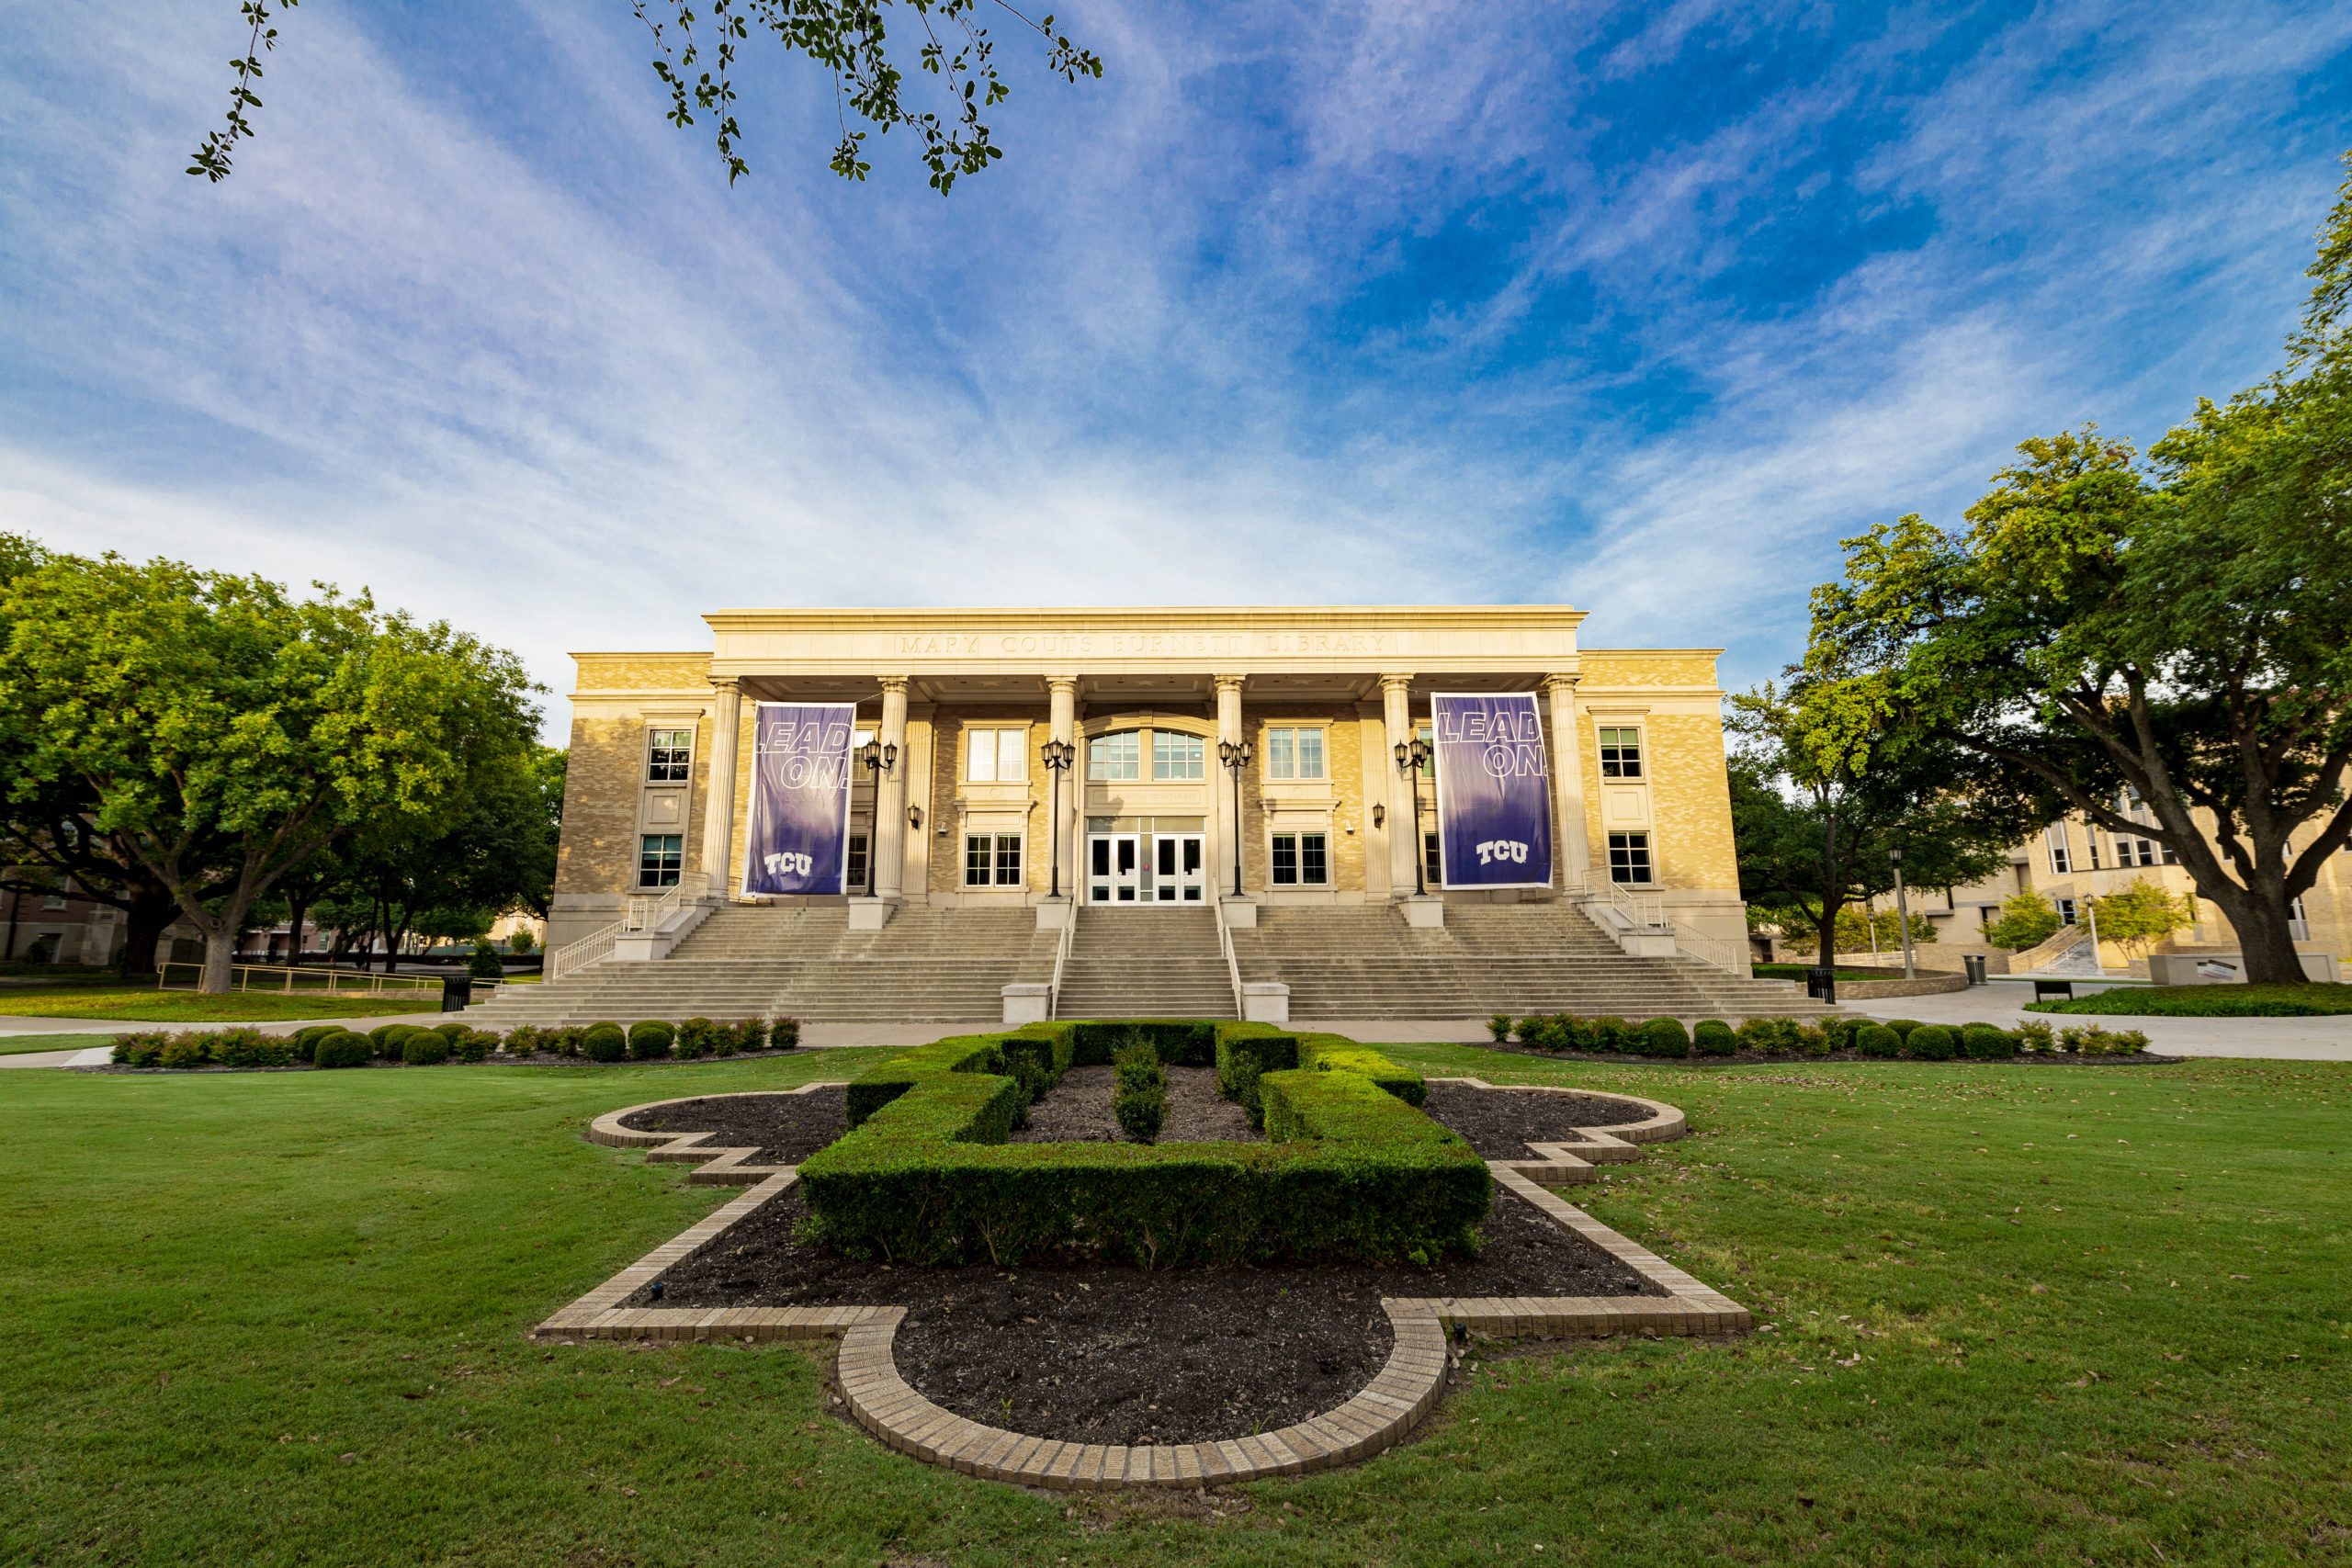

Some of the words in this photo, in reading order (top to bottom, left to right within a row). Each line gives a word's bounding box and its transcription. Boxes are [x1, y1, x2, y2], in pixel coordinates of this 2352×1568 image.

[900, 637, 979, 653] MARY
[1001, 637, 1092, 653] COUTS
[1112, 636, 1243, 652] BURNETT
[1264, 635, 1385, 651] LIBRARY
[1437, 712, 1541, 743] LEAD
[763, 852, 813, 876] TCU
[1476, 840, 1529, 865] TCU
